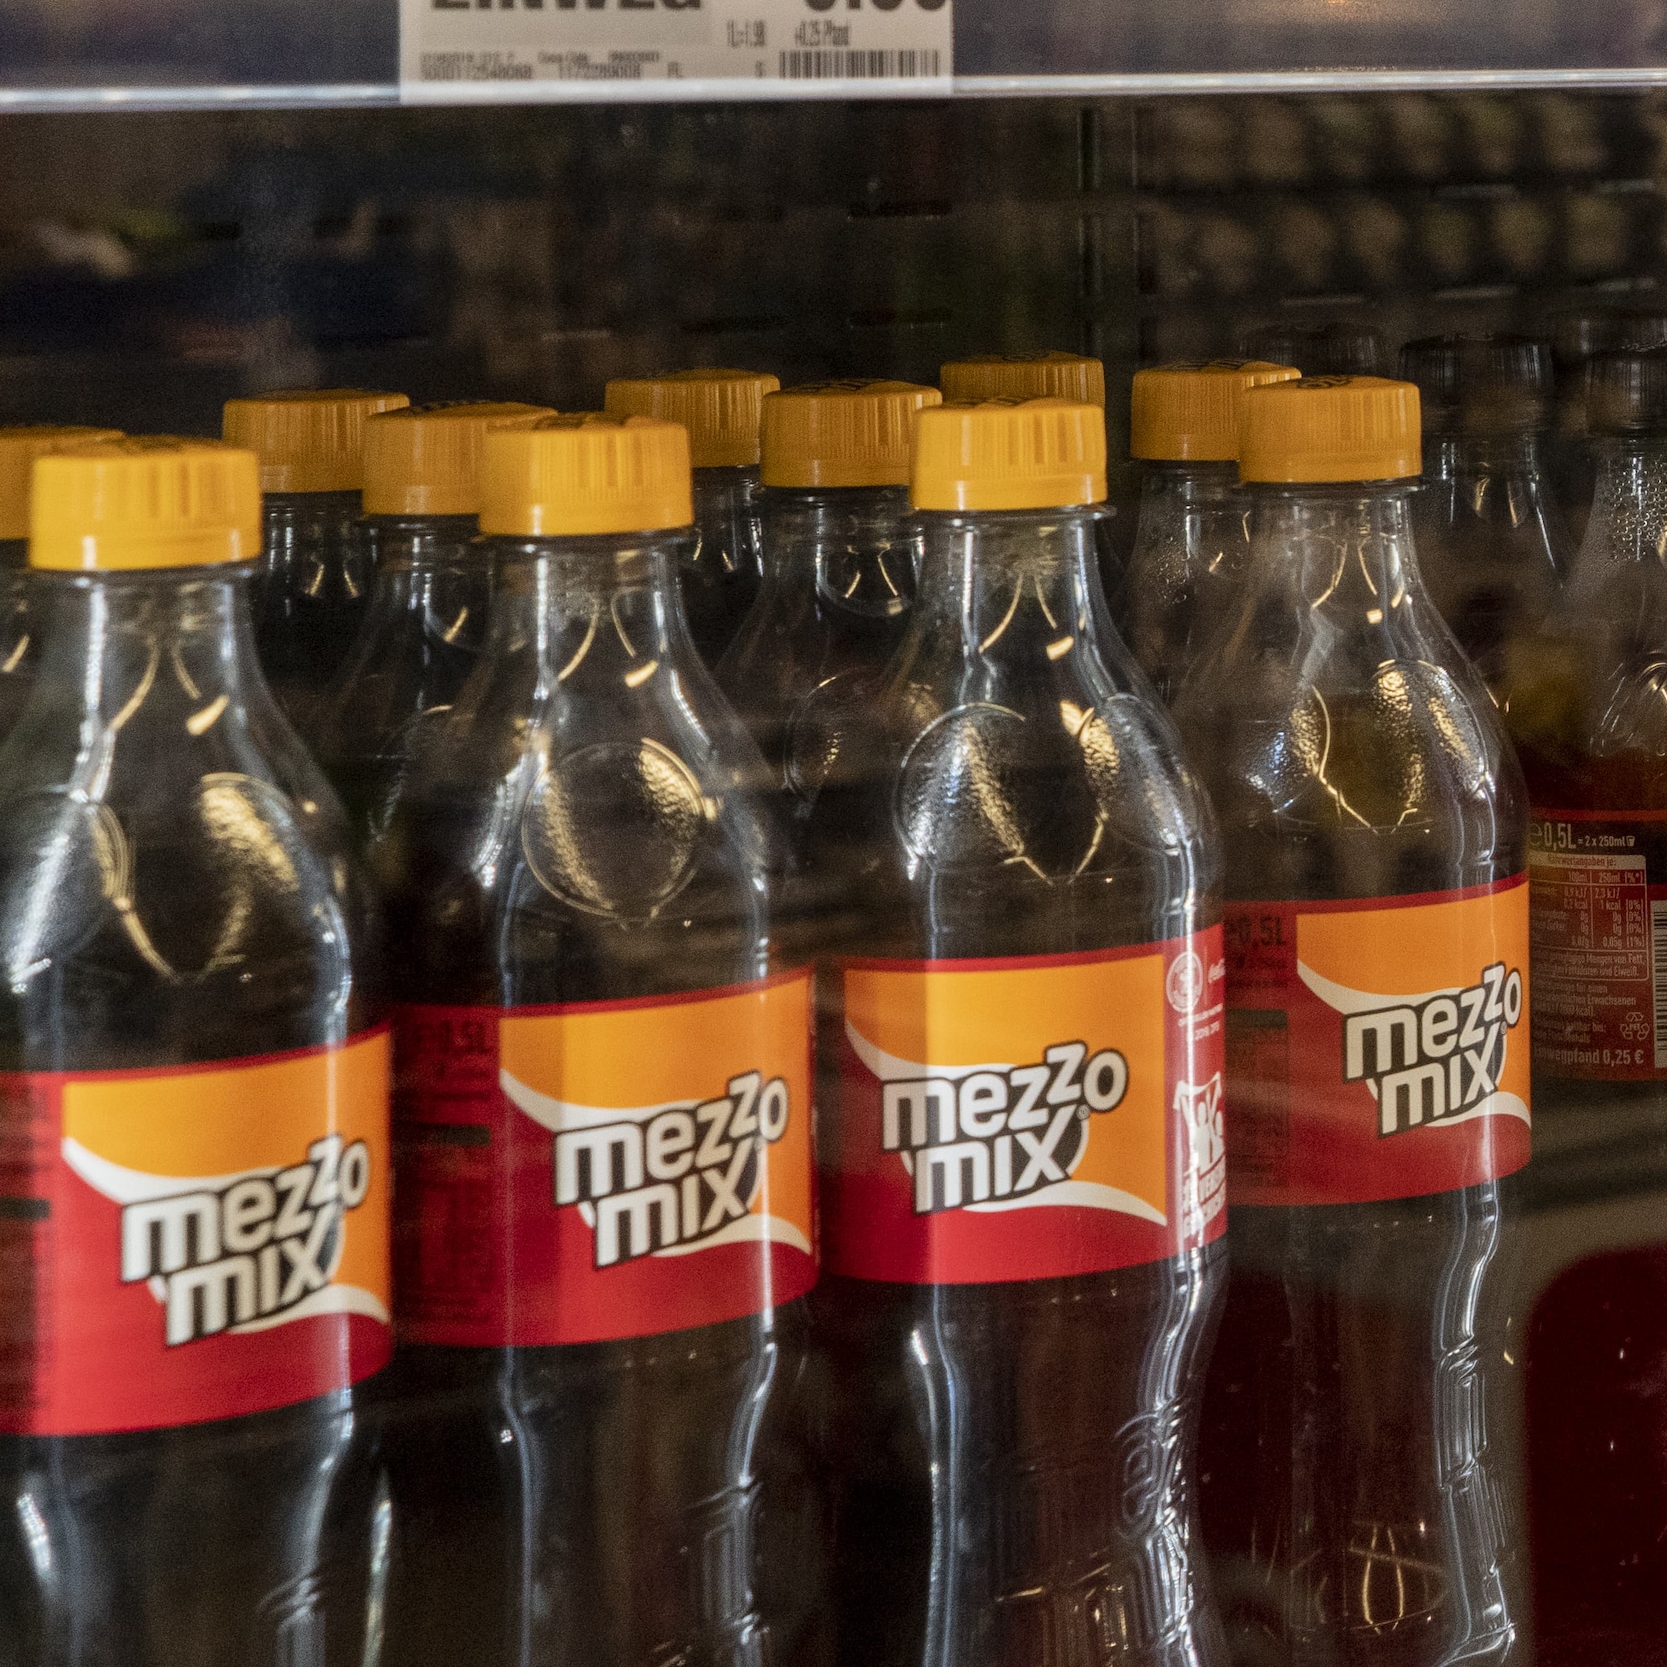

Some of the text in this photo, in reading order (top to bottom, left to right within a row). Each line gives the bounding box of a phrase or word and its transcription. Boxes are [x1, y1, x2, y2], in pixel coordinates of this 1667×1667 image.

[1543, 822, 1626, 850] 0,5L 250ml
[1343, 960, 1523, 1082] mezzo
[1376, 1022, 1502, 1138] mix
[1603, 1050, 1631, 1066] 0,25
[553, 1069, 789, 1208] mezzo
[882, 1038, 1128, 1155] mezzo
[119, 1133, 371, 1284] mezzo
[594, 1144, 755, 1269] mix
[913, 1107, 1077, 1214] mix
[163, 1205, 340, 1349] mix
